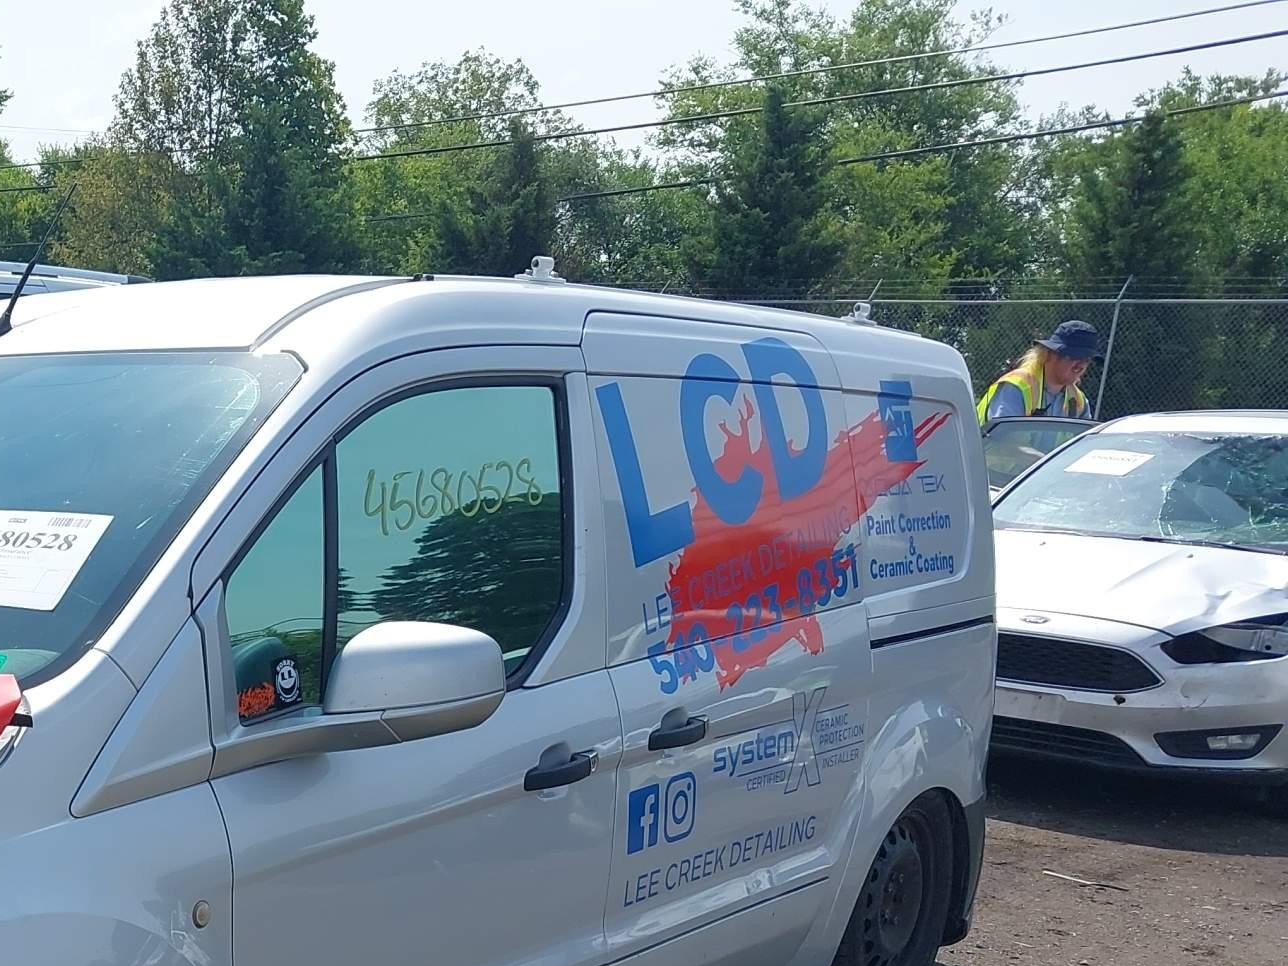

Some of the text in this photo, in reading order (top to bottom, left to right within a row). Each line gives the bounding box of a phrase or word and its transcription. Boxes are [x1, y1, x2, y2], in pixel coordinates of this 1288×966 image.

[595, 336, 828, 568] LCD
[364, 457, 543, 536] 45680528
[866, 511, 951, 536] Paint Correction
[909, 536, 916, 556] &
[642, 505, 852, 635] LEE CREEK DETAILING
[870, 552, 954, 579] Ceramic Coating
[647, 543, 860, 694] 540-223-8351
[816, 713, 848, 732] CERAMIC
[819, 723, 864, 745] PROTECTION
[713, 730, 794, 777] system
[822, 748, 859, 769] INSTALLER
[746, 769, 786, 791] CERTIFIED
[624, 815, 817, 907] LEE CREEK DETAILING
